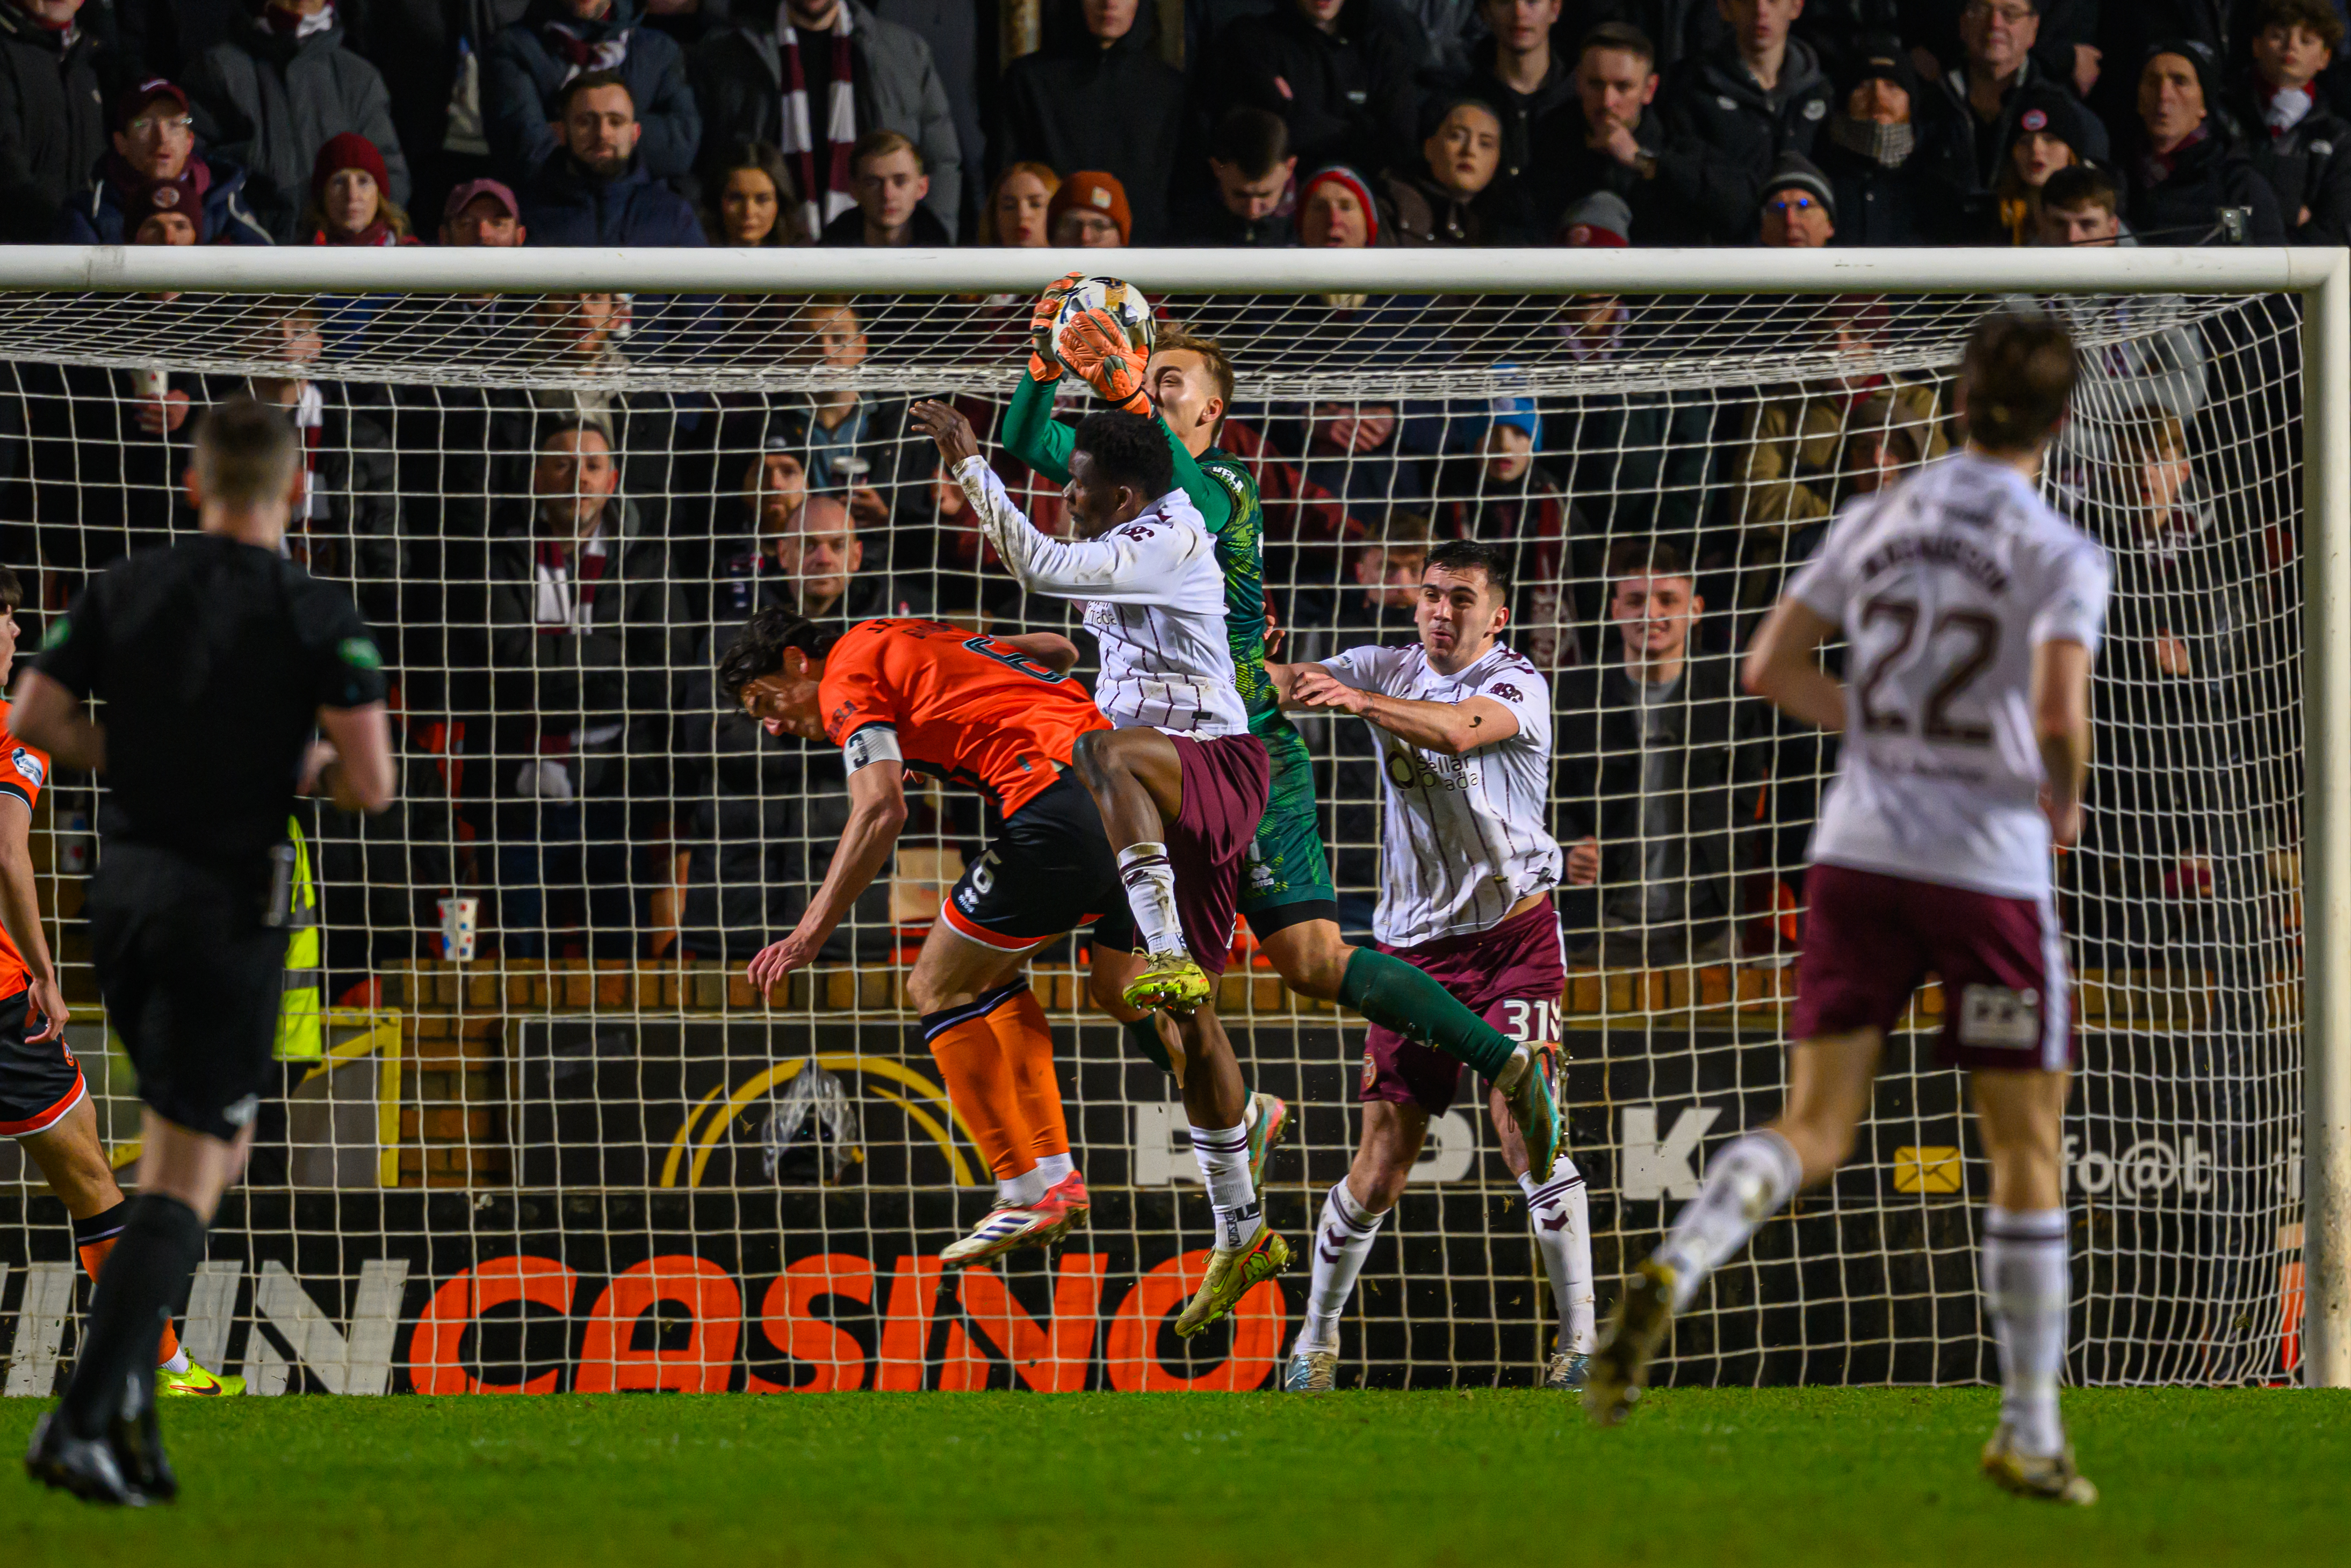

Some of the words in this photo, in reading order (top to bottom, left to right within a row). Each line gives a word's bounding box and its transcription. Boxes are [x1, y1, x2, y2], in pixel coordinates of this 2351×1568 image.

[1860, 596, 2002, 747] 22
[972, 849, 1002, 894] 6
[1503, 1000, 1549, 1041] 31
